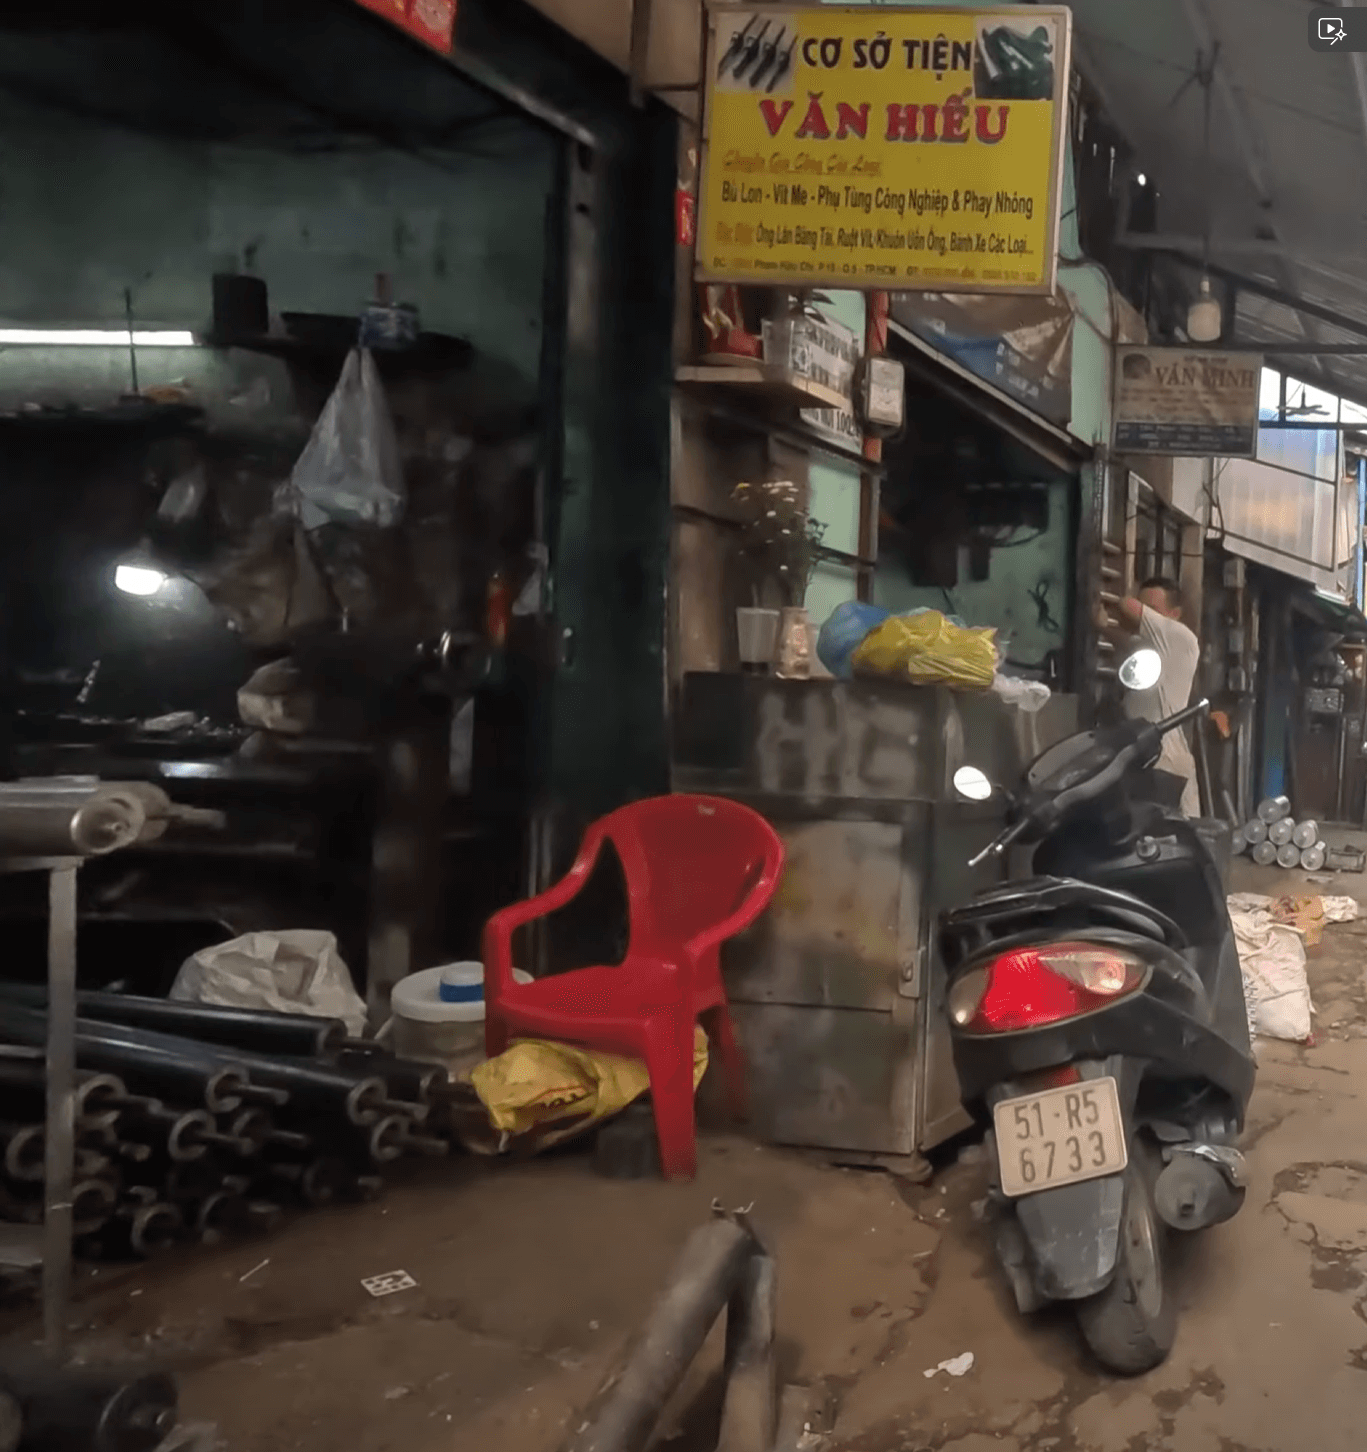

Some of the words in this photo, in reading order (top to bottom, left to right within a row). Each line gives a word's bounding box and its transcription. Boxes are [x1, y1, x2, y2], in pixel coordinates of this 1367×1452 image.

[802, 36, 843, 68] CƠ
[853, 30, 893, 69] SỞ
[903, 32, 973, 81] TIỆN
[759, 90, 871, 140] VĂN
[885, 87, 1010, 144] HIẾU
[741, 182, 763, 203] Lon
[909, 187, 948, 217] Nghiệp
[952, 189, 959, 211] &
[964, 190, 992, 218] Phay
[1021, 1131, 1106, 1183] 6733
